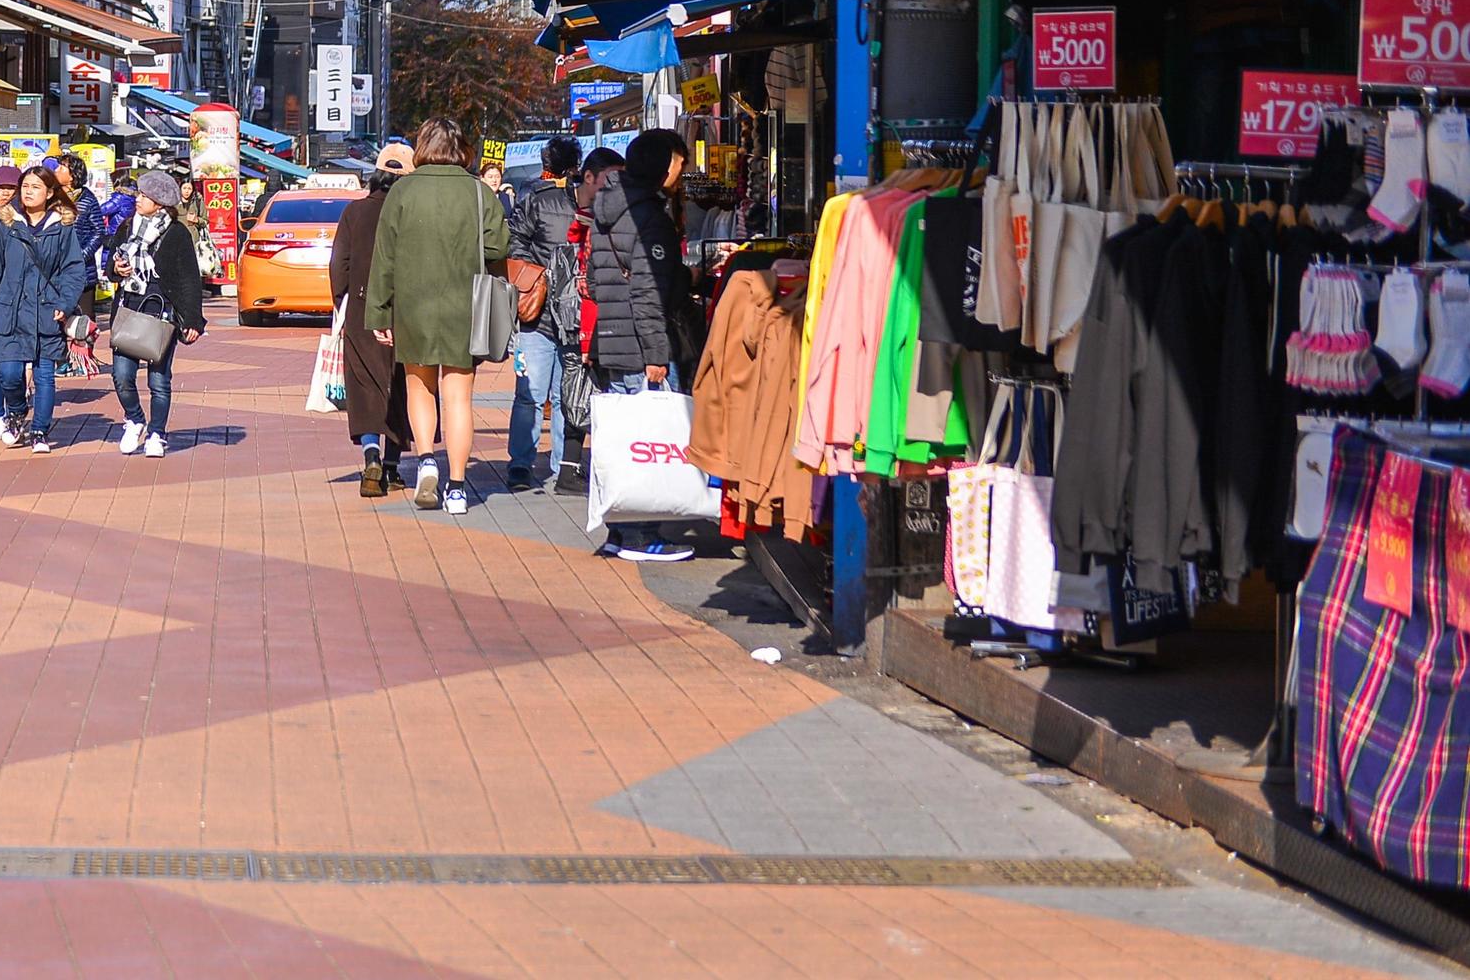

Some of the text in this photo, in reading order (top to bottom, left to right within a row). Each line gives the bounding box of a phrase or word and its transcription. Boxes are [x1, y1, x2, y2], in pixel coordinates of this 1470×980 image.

[327, 68, 341, 121] 三丁目
[483, 139, 506, 158] 반값
[630, 441, 690, 463] SPA
